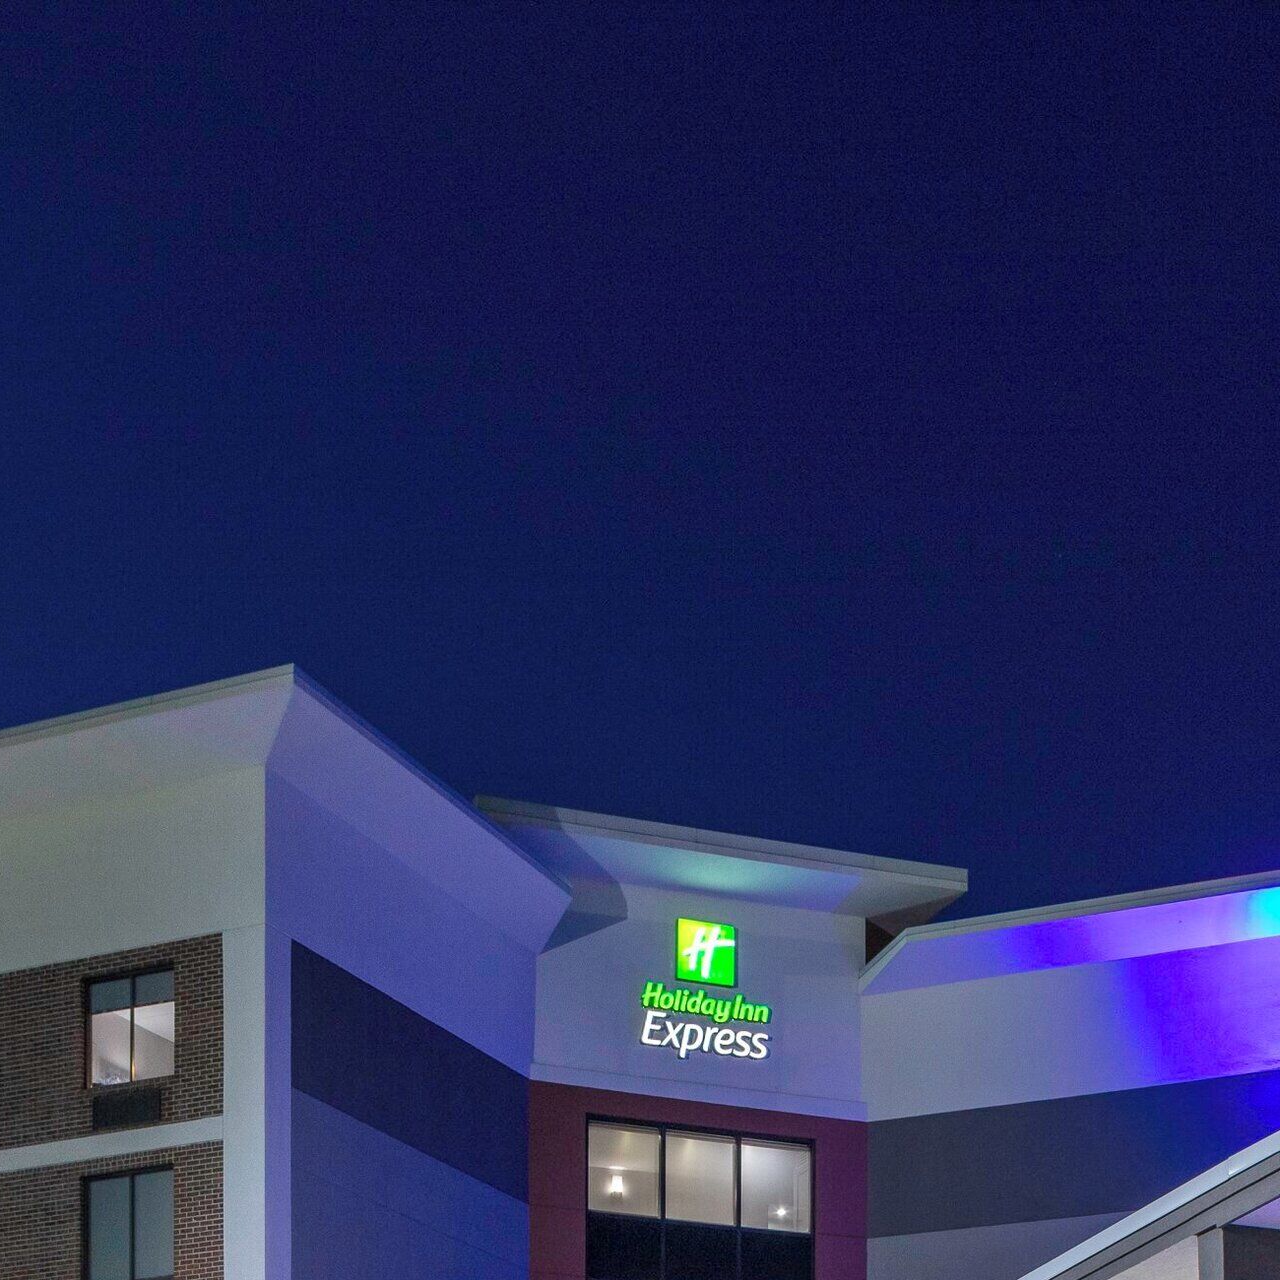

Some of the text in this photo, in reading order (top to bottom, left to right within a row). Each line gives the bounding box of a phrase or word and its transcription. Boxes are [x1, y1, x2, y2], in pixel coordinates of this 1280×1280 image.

[682, 926, 735, 978] H
[642, 982, 769, 1022] Holiday Inn
[641, 1010, 769, 1059] Express
